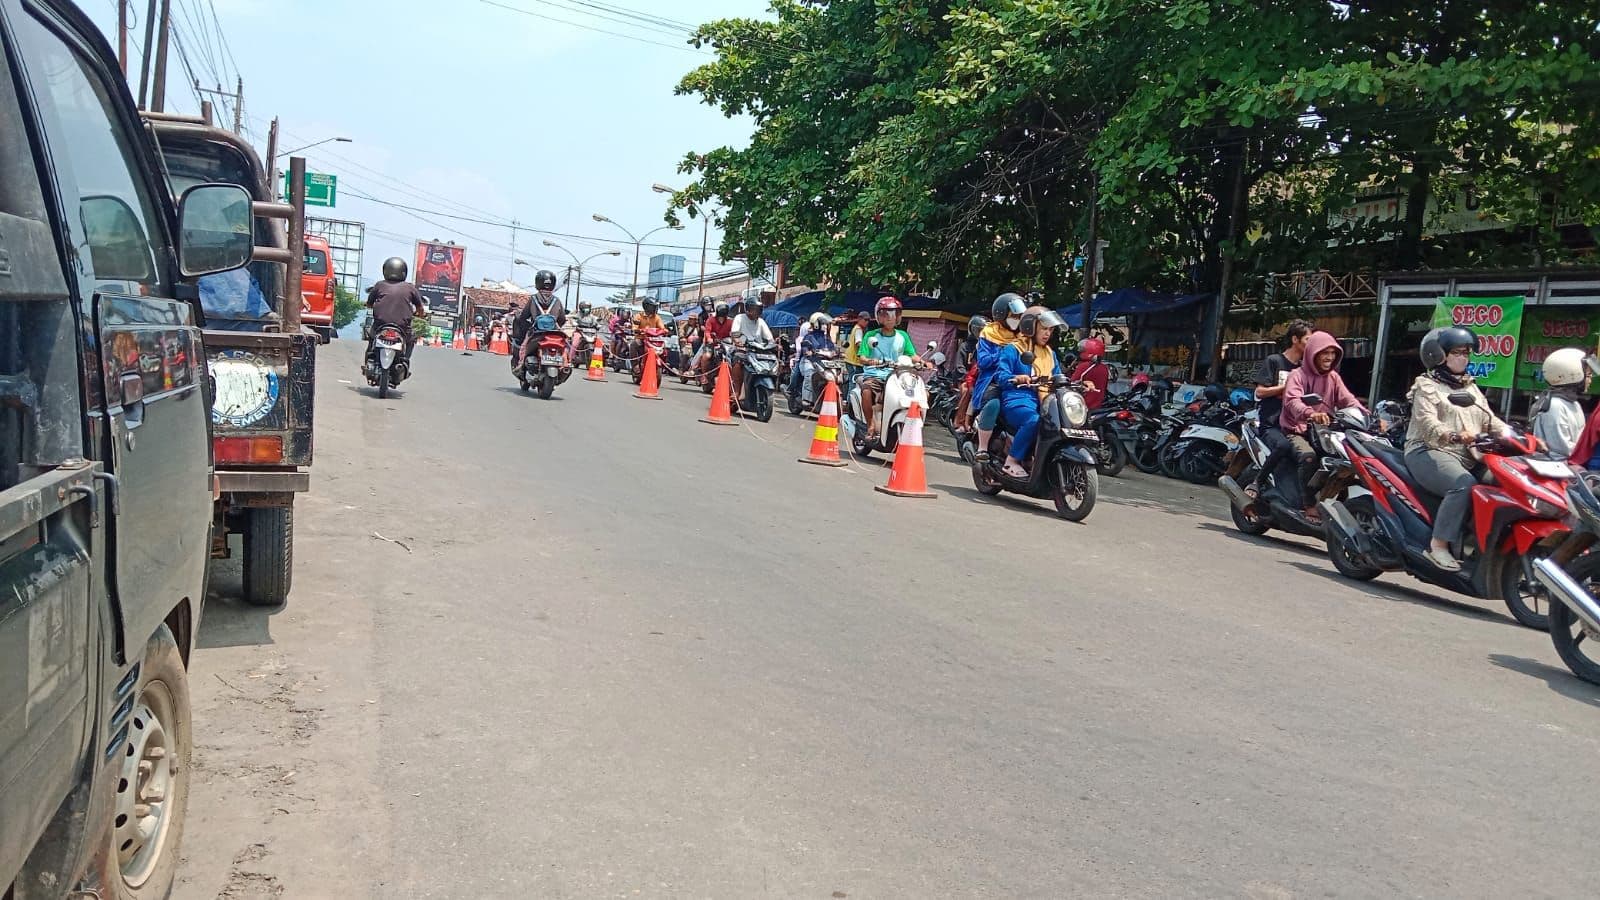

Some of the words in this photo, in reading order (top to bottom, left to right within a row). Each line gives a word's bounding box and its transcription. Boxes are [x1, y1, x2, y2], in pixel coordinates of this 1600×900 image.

[1452, 304, 1503, 326] SEGO
[1542, 319, 1590, 337] SEGO
[1474, 335, 1516, 357] ONO
